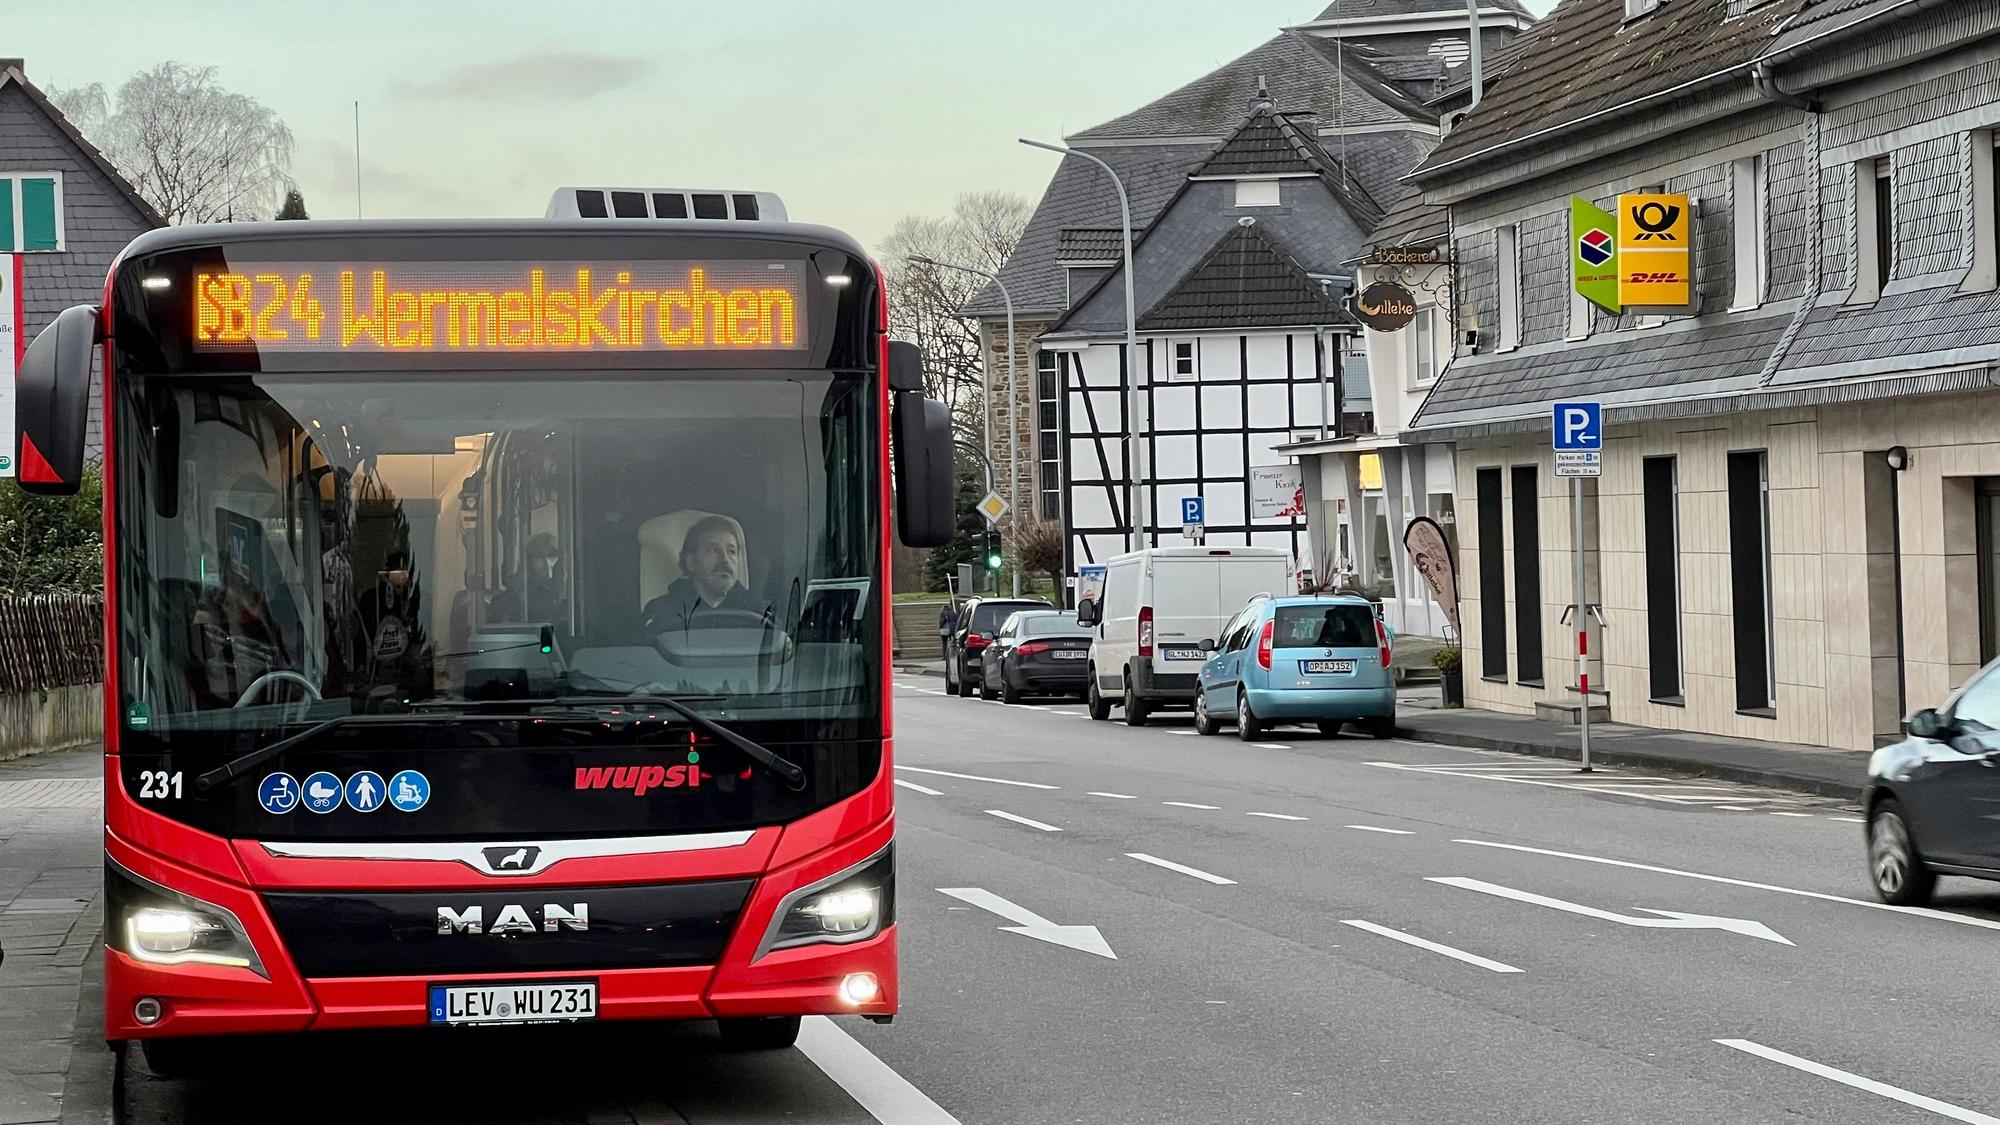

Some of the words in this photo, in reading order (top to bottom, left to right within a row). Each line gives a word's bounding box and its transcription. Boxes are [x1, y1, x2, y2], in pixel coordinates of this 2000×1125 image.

[1630, 272, 1679, 283] DHL
[198, 273, 325, 339] SB24
[341, 268, 794, 346] Wermelskirchen
[1564, 408, 1590, 444] P
[1186, 500, 1198, 520] P
[1309, 662, 1319, 670] OP
[1324, 662, 1335, 670] AJ
[1336, 662, 1350, 670] 152
[139, 770, 183, 799] 231
[575, 751, 700, 796] wupsi
[437, 902, 589, 935] MAN
[450, 991, 494, 1017] LEV
[513, 990, 543, 1015] WU
[550, 988, 593, 1014] 231
